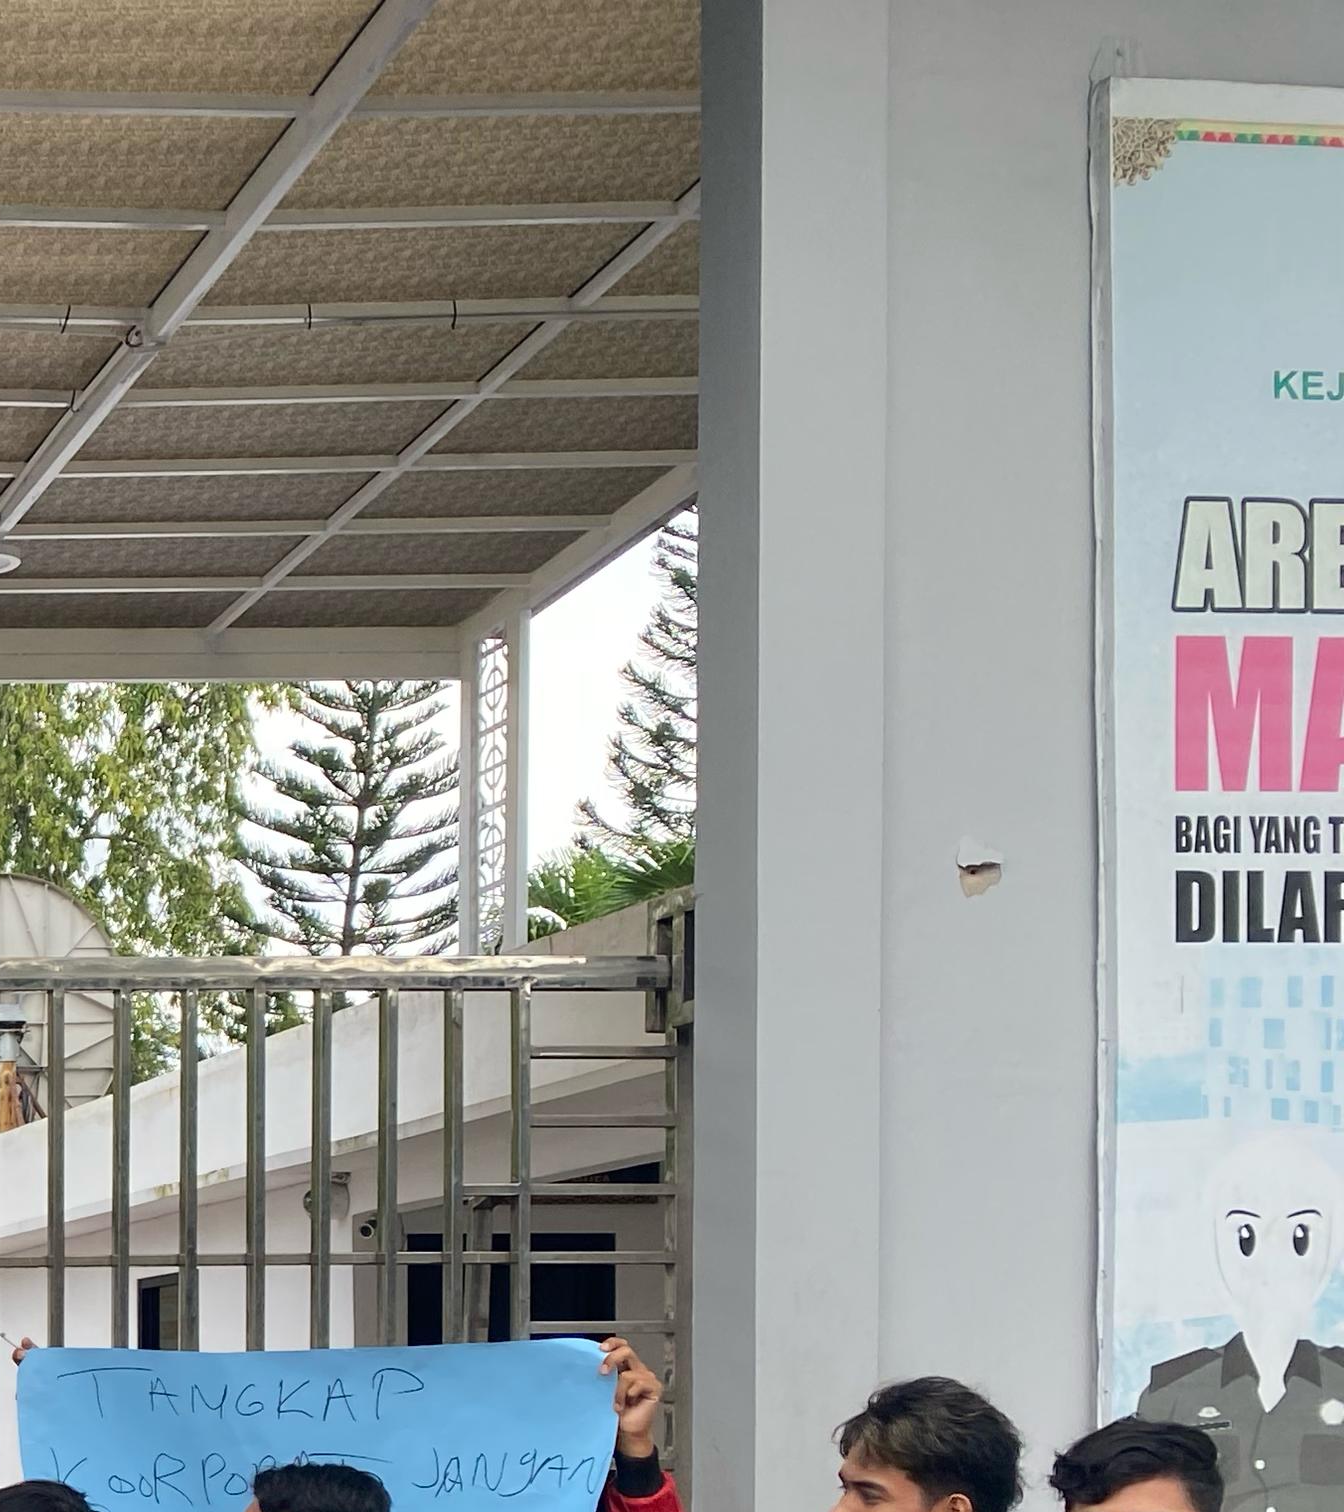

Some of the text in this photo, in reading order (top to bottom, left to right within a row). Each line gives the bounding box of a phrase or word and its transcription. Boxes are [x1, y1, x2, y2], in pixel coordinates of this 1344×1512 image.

[1273, 370, 1344, 401] KEJ
[1175, 815, 1241, 854] BAGI
[1249, 815, 1321, 854] YANG
[56, 1366, 424, 1421] TANGKAP
